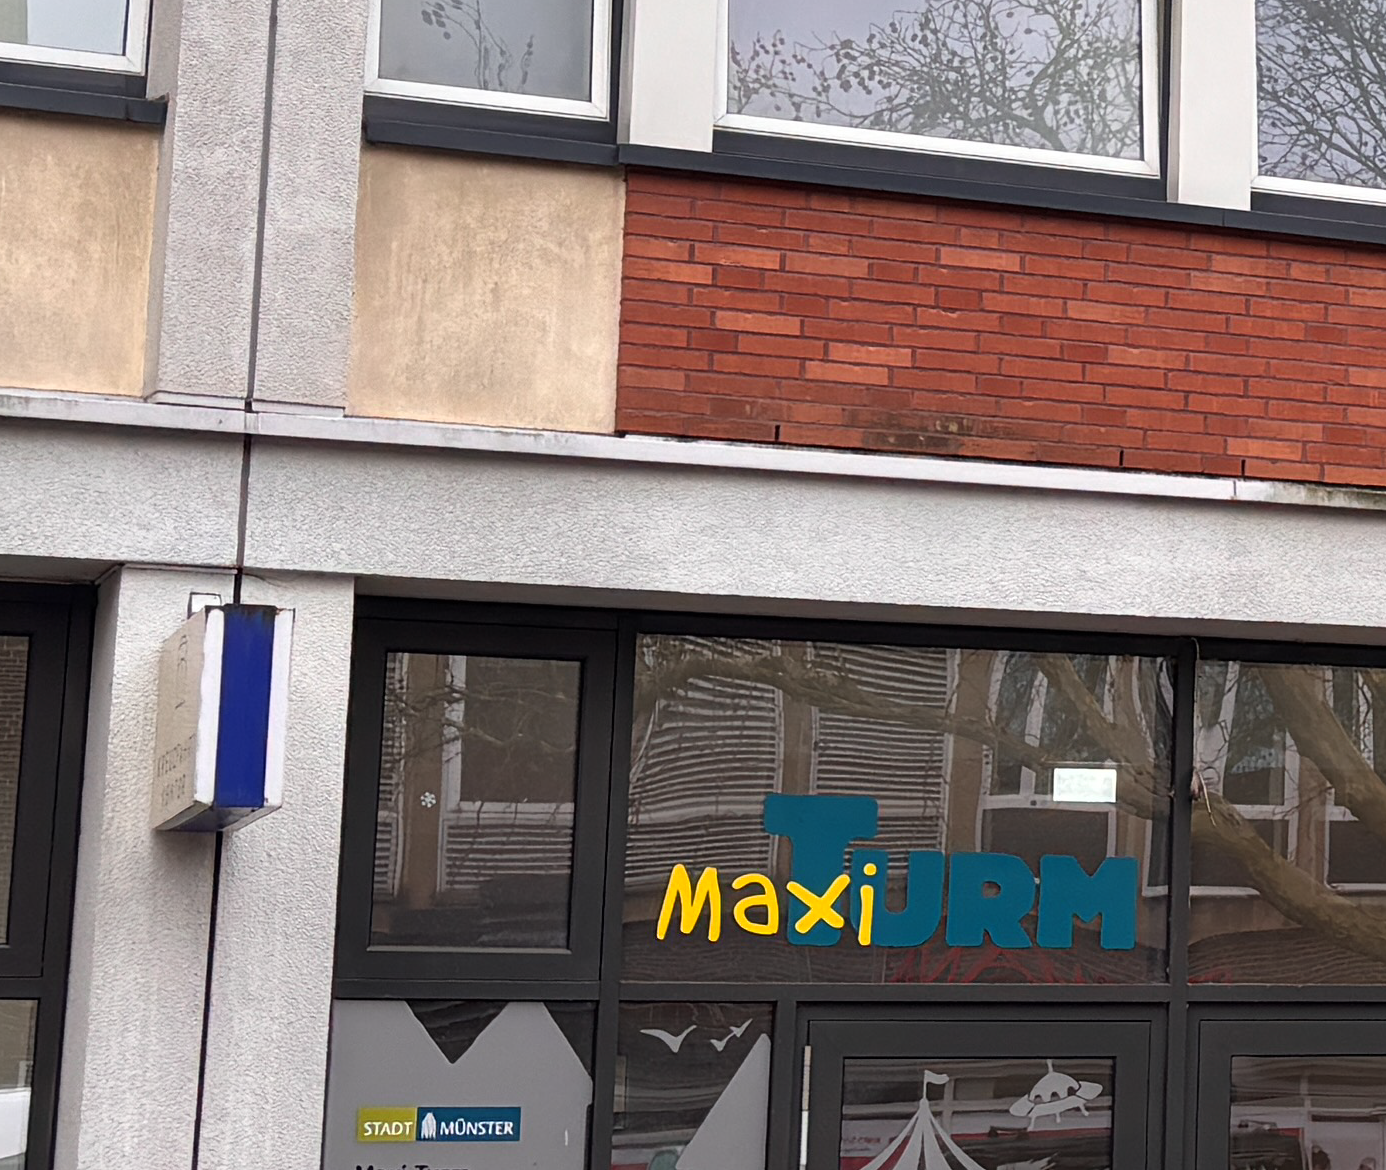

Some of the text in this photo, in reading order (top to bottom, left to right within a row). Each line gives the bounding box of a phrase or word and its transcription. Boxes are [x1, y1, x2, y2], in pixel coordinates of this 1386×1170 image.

[656, 863, 877, 947] Maxi
[363, 1118, 514, 1136] STADT MÜNSTER
